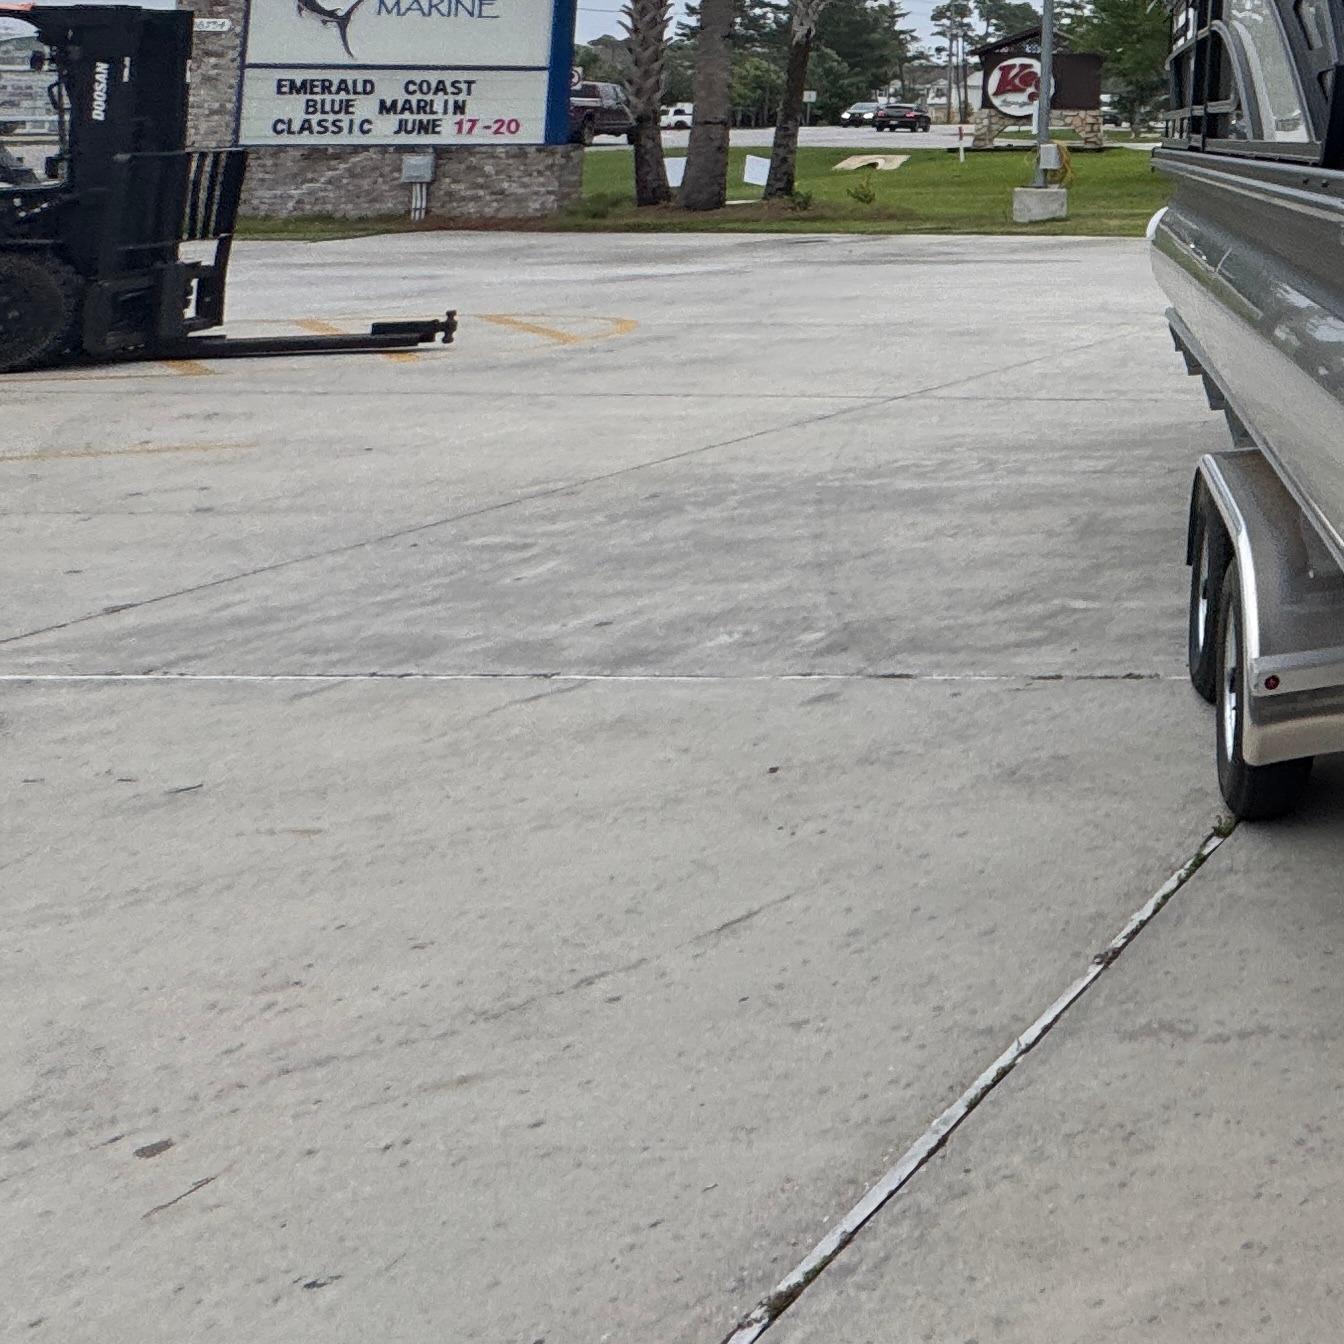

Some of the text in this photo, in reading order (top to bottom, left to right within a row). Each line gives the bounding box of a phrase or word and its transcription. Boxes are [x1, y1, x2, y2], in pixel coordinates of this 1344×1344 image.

[92, 61, 110, 122] DOOSAN
[275, 78, 477, 97] EMERALD COAST
[304, 98, 467, 116] BLUE MARLIN
[271, 117, 521, 136] CLASSIC JUNE 17-20
